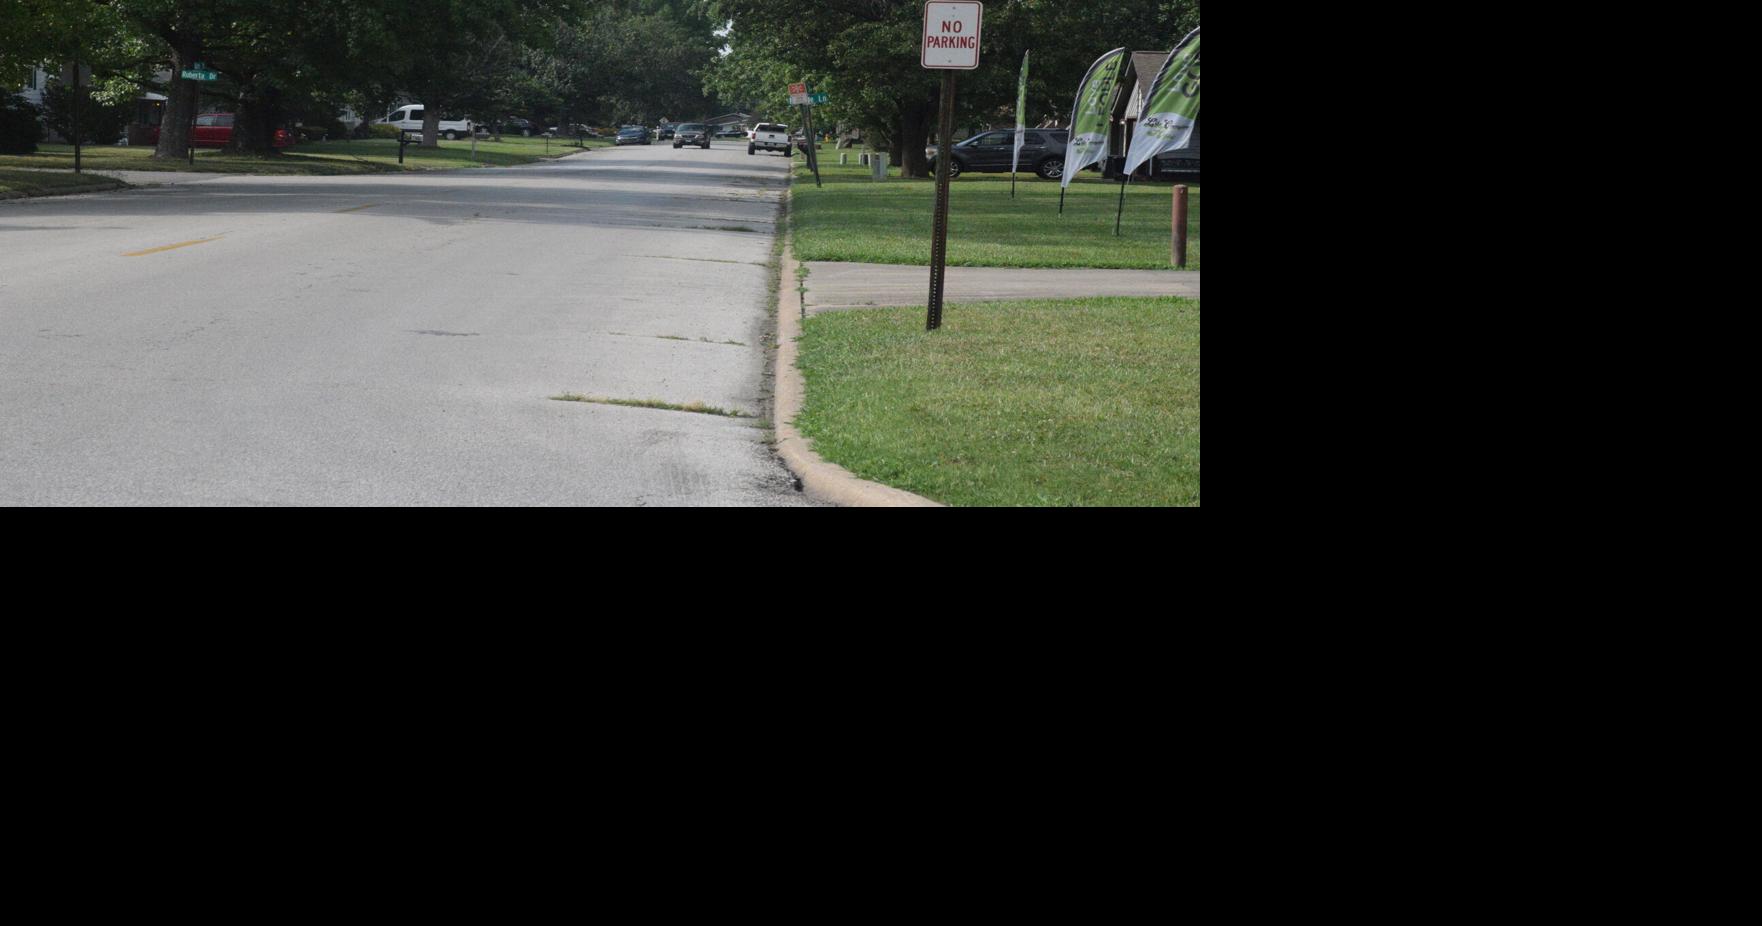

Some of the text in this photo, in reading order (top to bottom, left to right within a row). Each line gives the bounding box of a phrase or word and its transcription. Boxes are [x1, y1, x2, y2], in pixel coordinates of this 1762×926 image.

[941, 20, 963, 33] NO
[927, 36, 976, 49] PARKING
[181, 70, 217, 80] Roberta Dr
[818, 95, 827, 103] Ln
